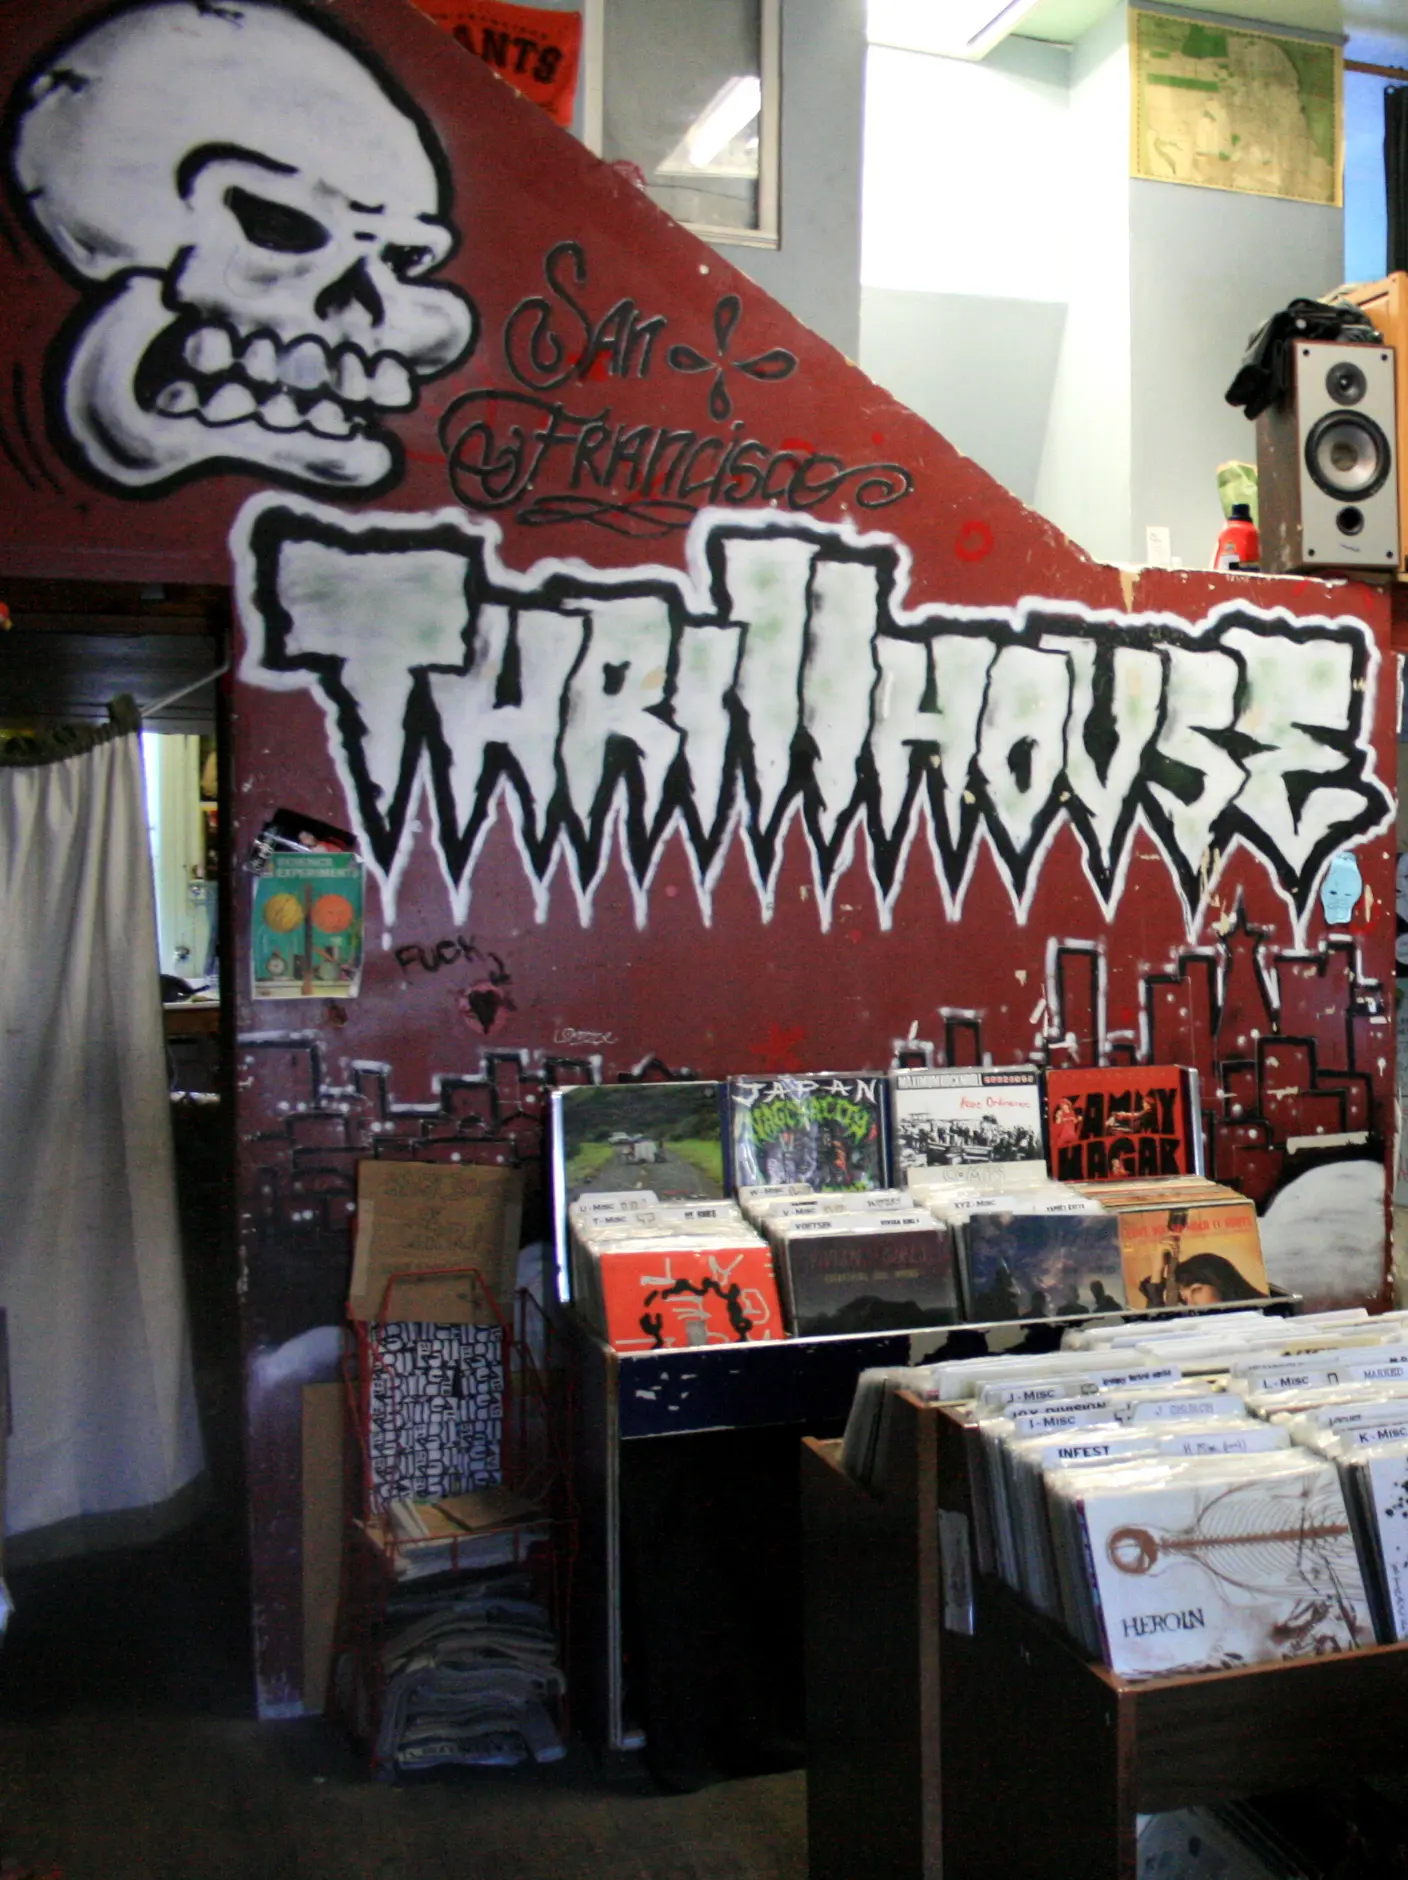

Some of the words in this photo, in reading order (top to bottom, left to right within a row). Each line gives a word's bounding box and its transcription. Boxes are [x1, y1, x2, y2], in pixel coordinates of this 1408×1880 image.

[395, 935, 484, 974] FUCK
[1058, 1445, 1110, 1459] INFEST
[1122, 1607, 1206, 1638] HEROIN
